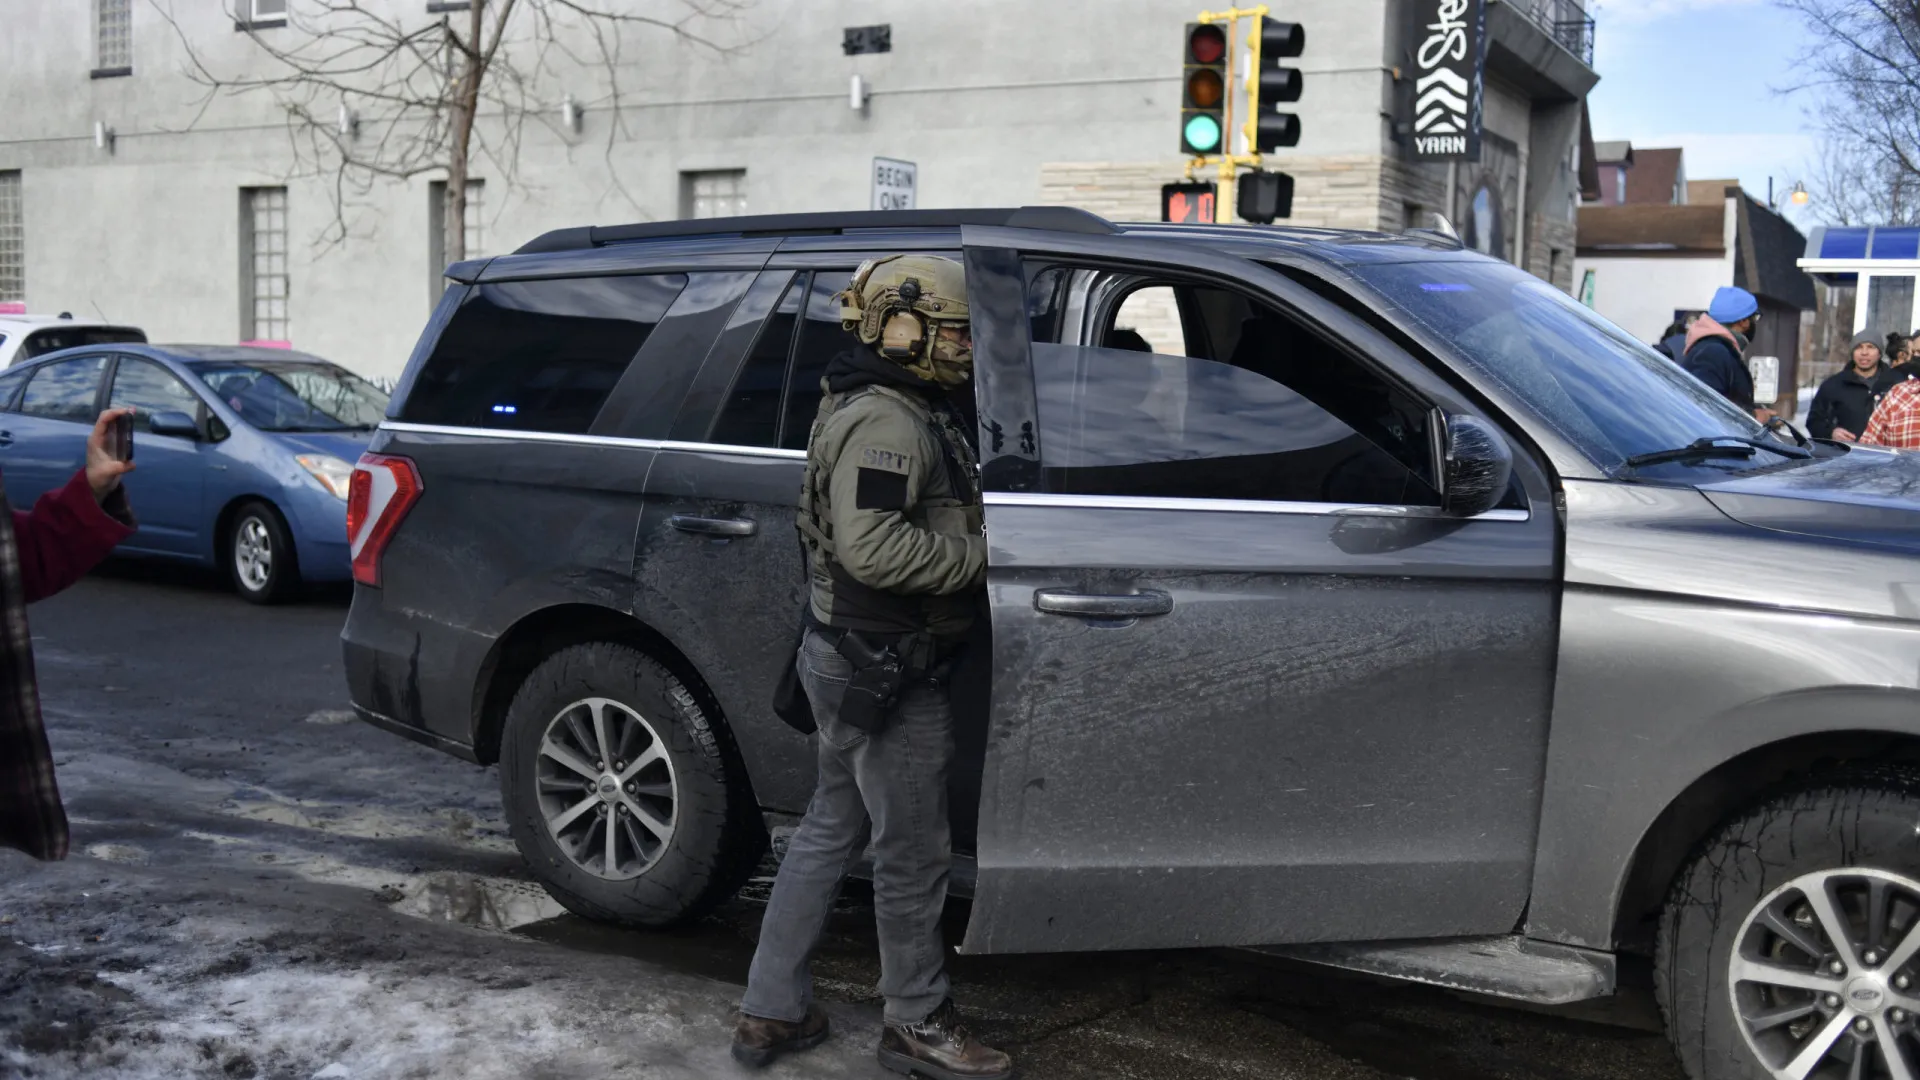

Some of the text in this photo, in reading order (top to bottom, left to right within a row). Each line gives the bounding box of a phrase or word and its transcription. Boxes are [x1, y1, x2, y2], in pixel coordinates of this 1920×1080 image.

[1415, 135, 1466, 154] YARN
[876, 166, 912, 189] BEGIN
[863, 448, 907, 470] SRT
